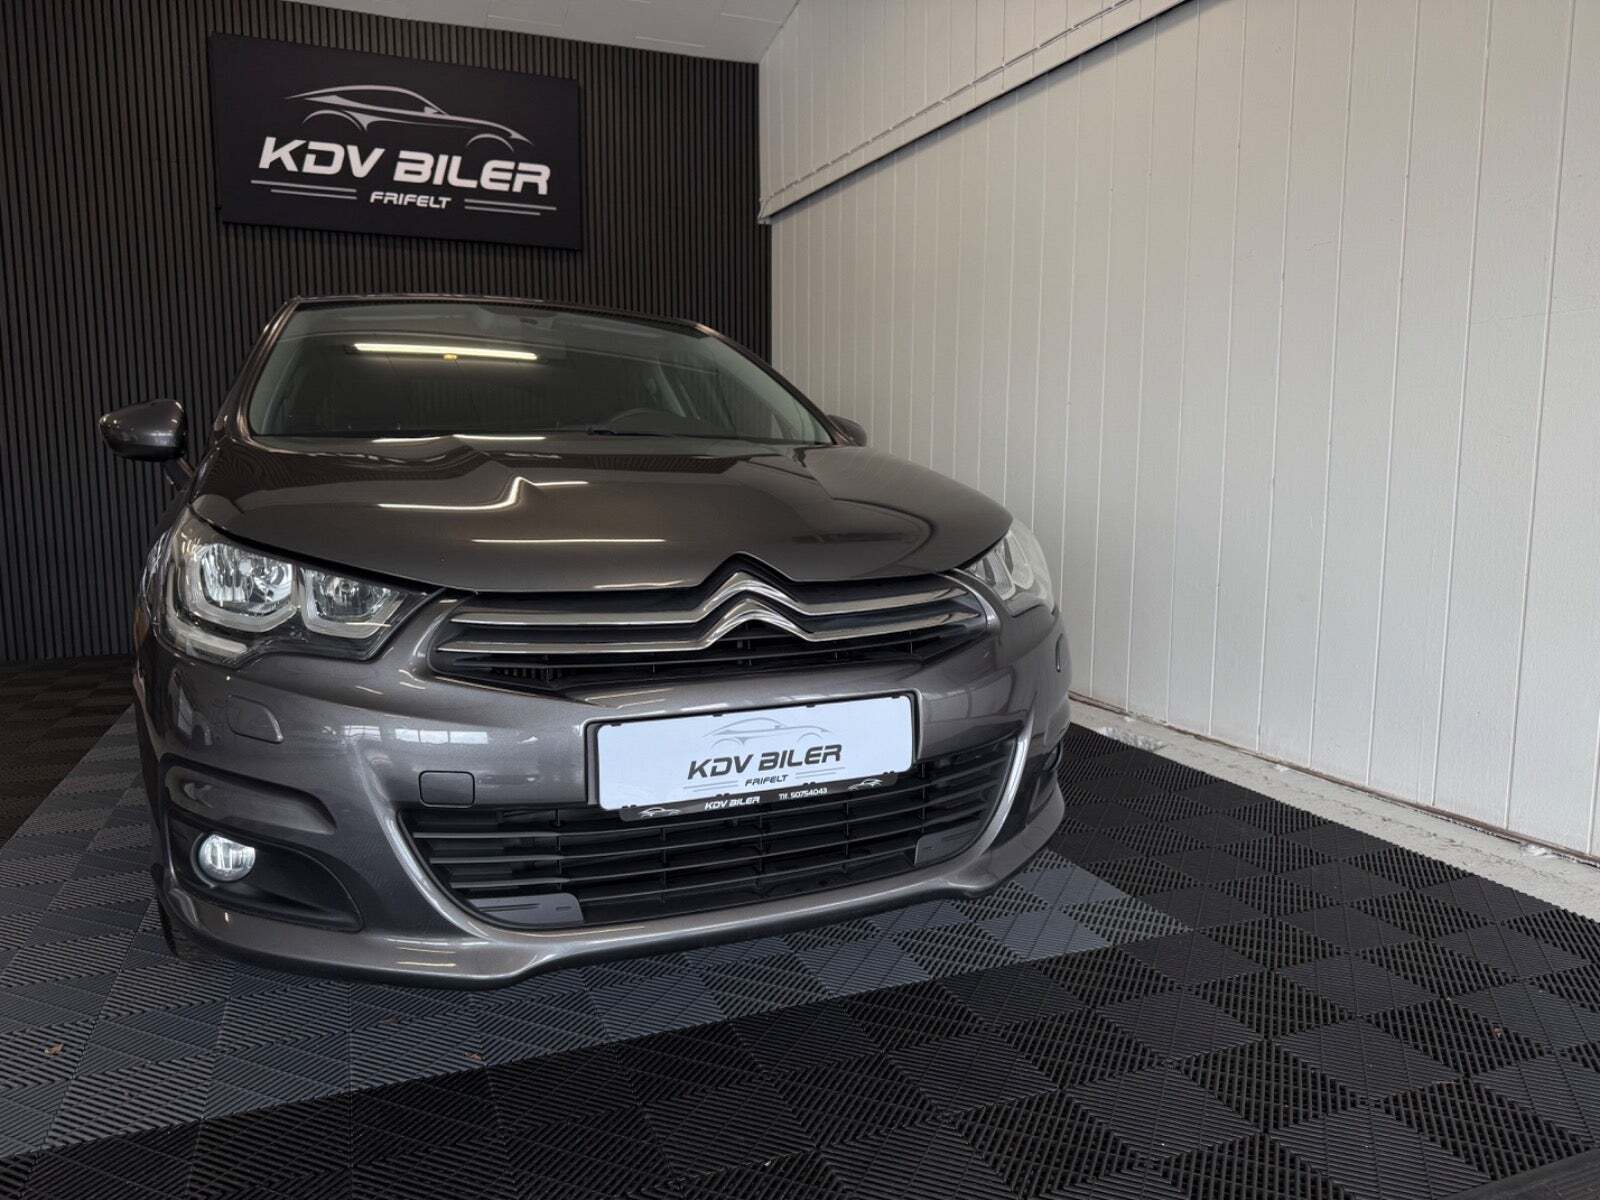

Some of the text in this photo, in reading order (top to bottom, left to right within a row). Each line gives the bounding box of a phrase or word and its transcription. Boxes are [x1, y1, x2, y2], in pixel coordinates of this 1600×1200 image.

[258, 136, 551, 195] KDV BILER
[370, 191, 452, 209] FRIFELT
[687, 744, 842, 780] KDV BILER
[744, 774, 789, 787] FRIFELT
[704, 796, 760, 810] KDV BILER
